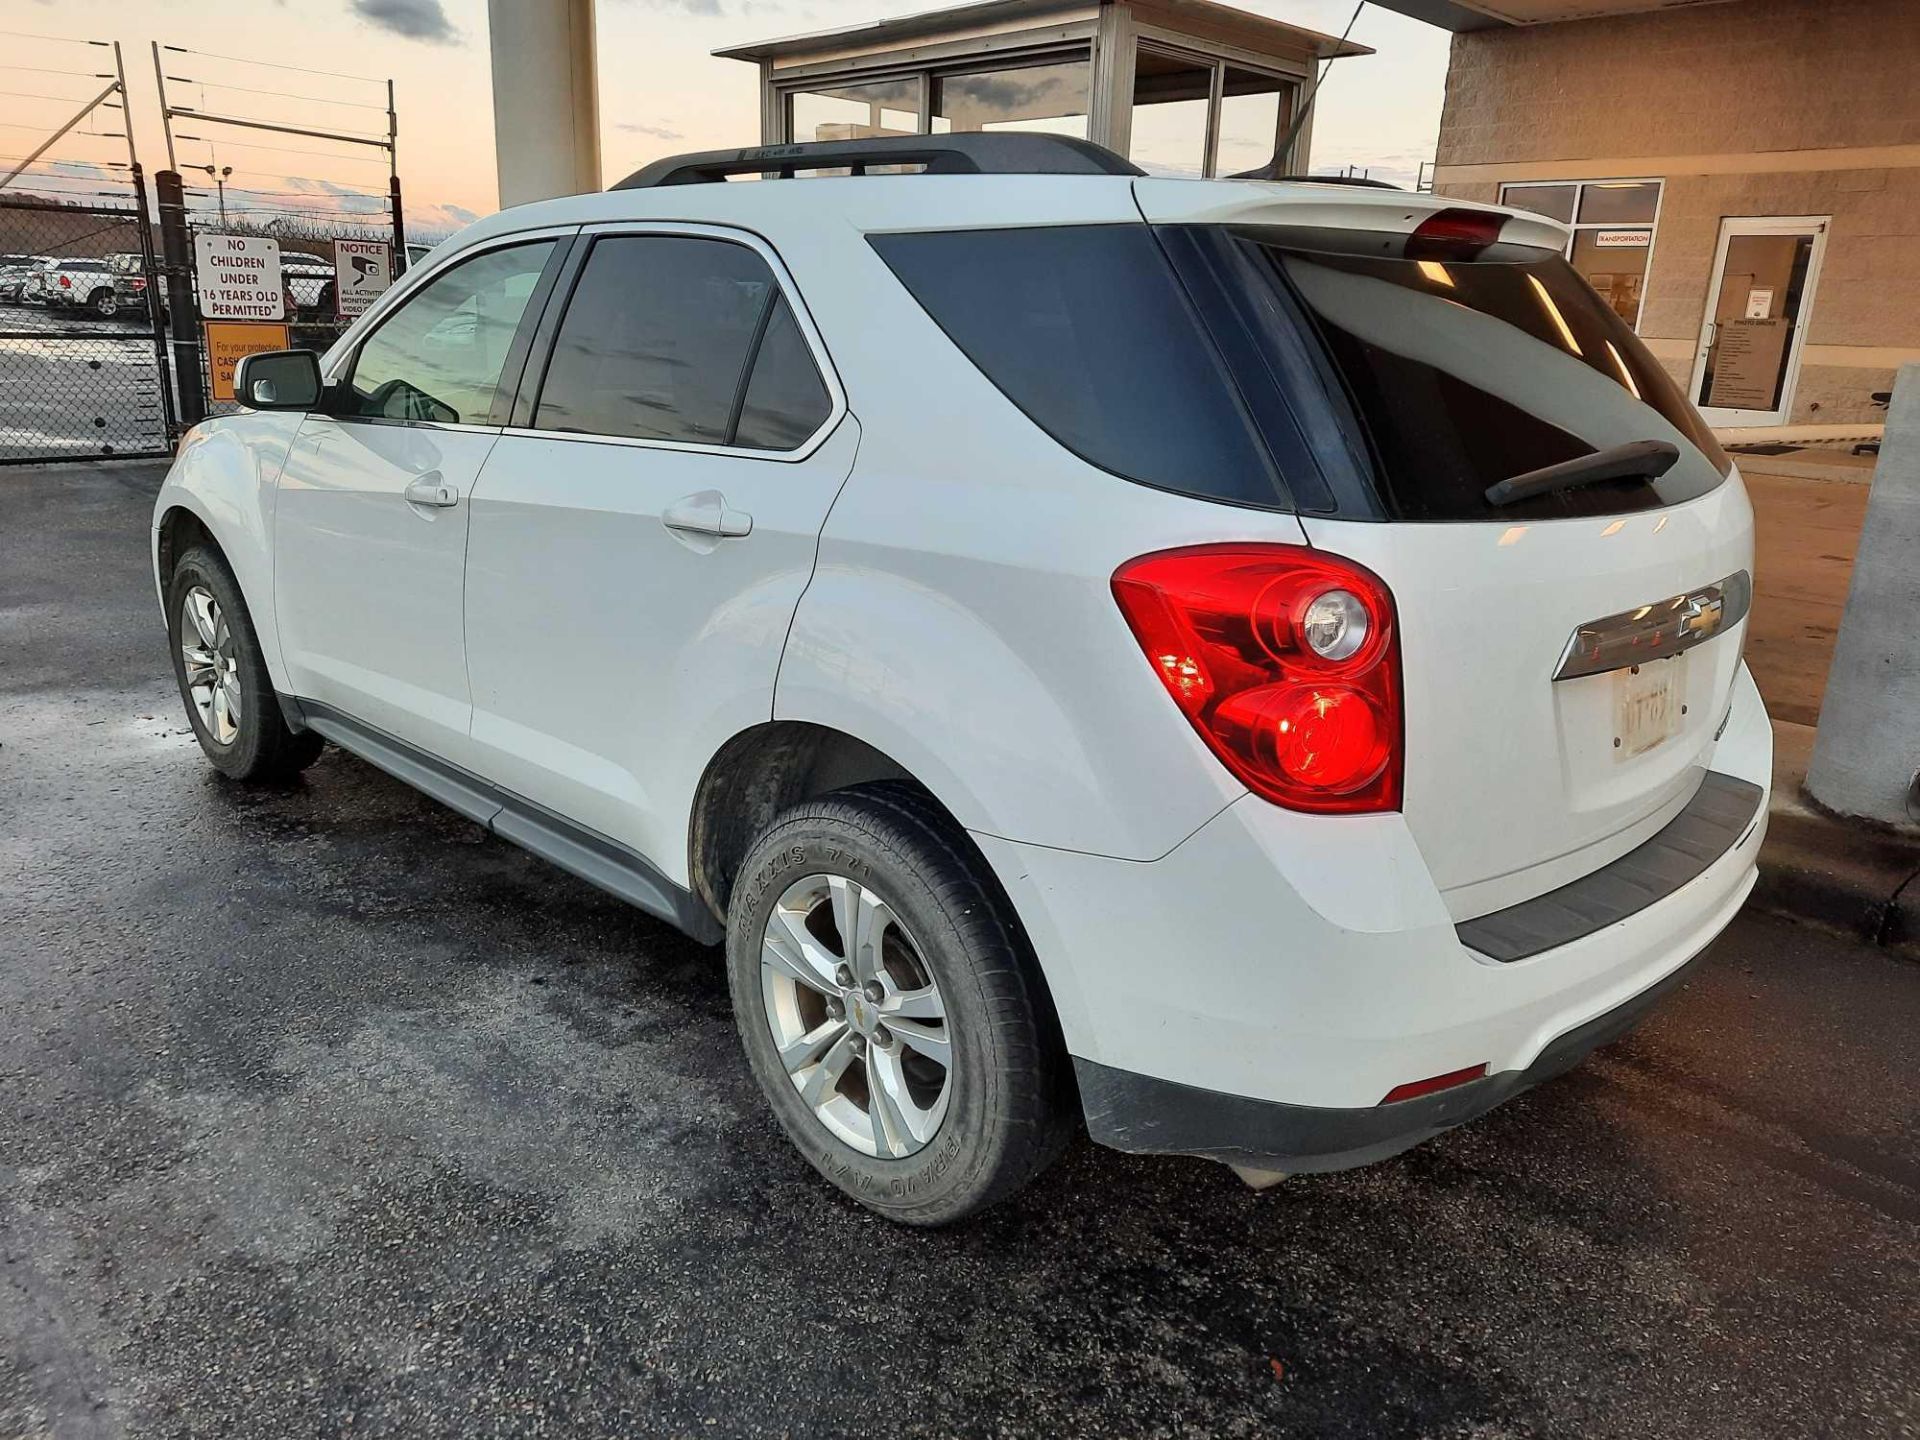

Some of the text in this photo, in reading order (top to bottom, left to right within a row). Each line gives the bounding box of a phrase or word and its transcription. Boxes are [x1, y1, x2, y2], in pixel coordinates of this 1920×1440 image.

[227, 240, 245, 251] NO
[340, 243, 382, 254] NOTICE
[210, 255, 265, 269] CHILDREN
[220, 273, 258, 285] UNDER
[203, 289, 278, 302] 16 YEARS OLD
[212, 302, 272, 316] PERMITTED
[216, 341, 229, 351] For
[230, 343, 246, 354] your
[739, 846, 873, 941] MAXXIS 771
